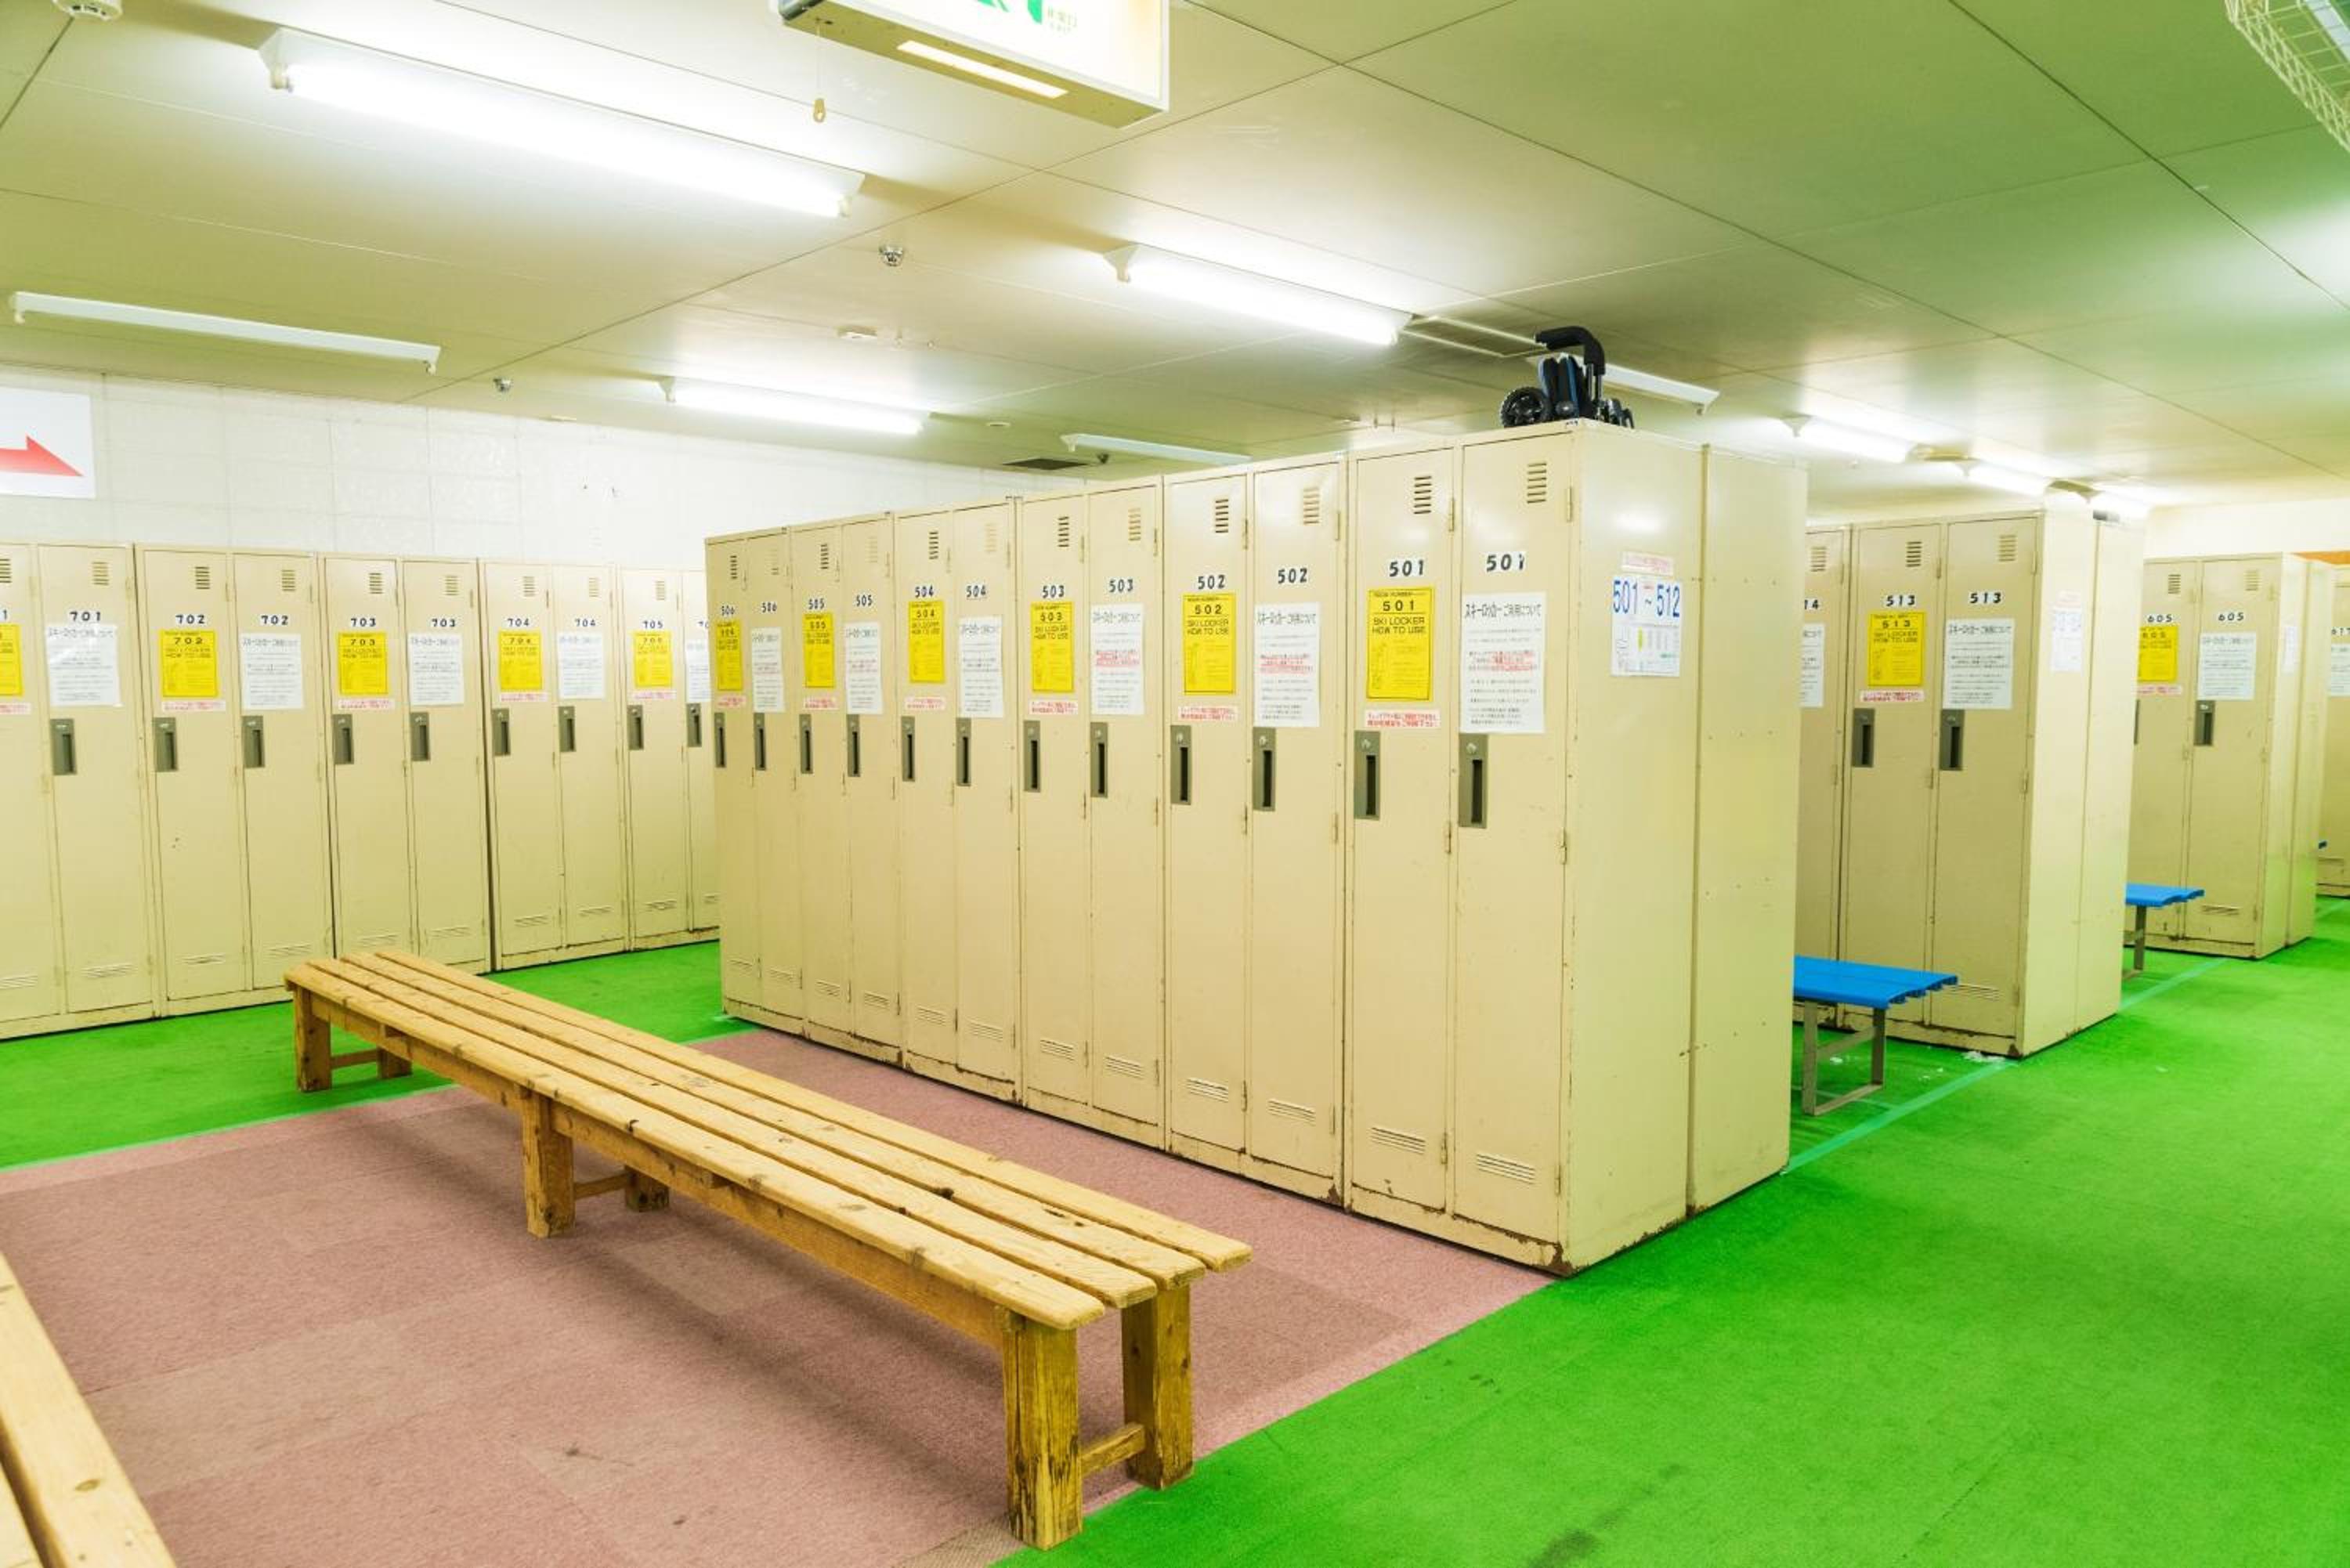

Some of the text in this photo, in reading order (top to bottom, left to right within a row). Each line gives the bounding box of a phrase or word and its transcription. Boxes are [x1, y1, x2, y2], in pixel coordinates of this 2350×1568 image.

[1389, 559, 1424, 577] 501
[1486, 553, 1524, 573] 501
[1278, 568, 1307, 584] 502
[1109, 579, 1133, 593] 503
[1198, 574, 1225, 589] 502
[915, 585, 934, 598] 504
[966, 585, 986, 598] 504
[1043, 585, 1065, 598] 503
[856, 594, 873, 606] 505
[1886, 595, 1915, 607] 513
[1969, 592, 2001, 604] 513
[808, 598, 825, 609] 505
[1383, 599, 1414, 612] 501
[1804, 599, 1819, 609] 14
[916, 609, 935, 618] 504
[1195, 604, 1222, 615] 502
[69, 611, 101, 621] 701
[175, 614, 204, 624] 702
[261, 615, 288, 625] 702
[1040, 612, 1062, 621] 503
[1390, 616, 1424, 625] LOCKER
[2147, 614, 2172, 623] 605
[2218, 612, 2244, 621] 605
[351, 618, 376, 627] 703
[432, 618, 455, 627] 703
[507, 618, 530, 627] 704
[574, 618, 595, 627] 704
[642, 620, 663, 629] 705
[698, 620, 709, 629] 70
[1882, 620, 1911, 629] 513
